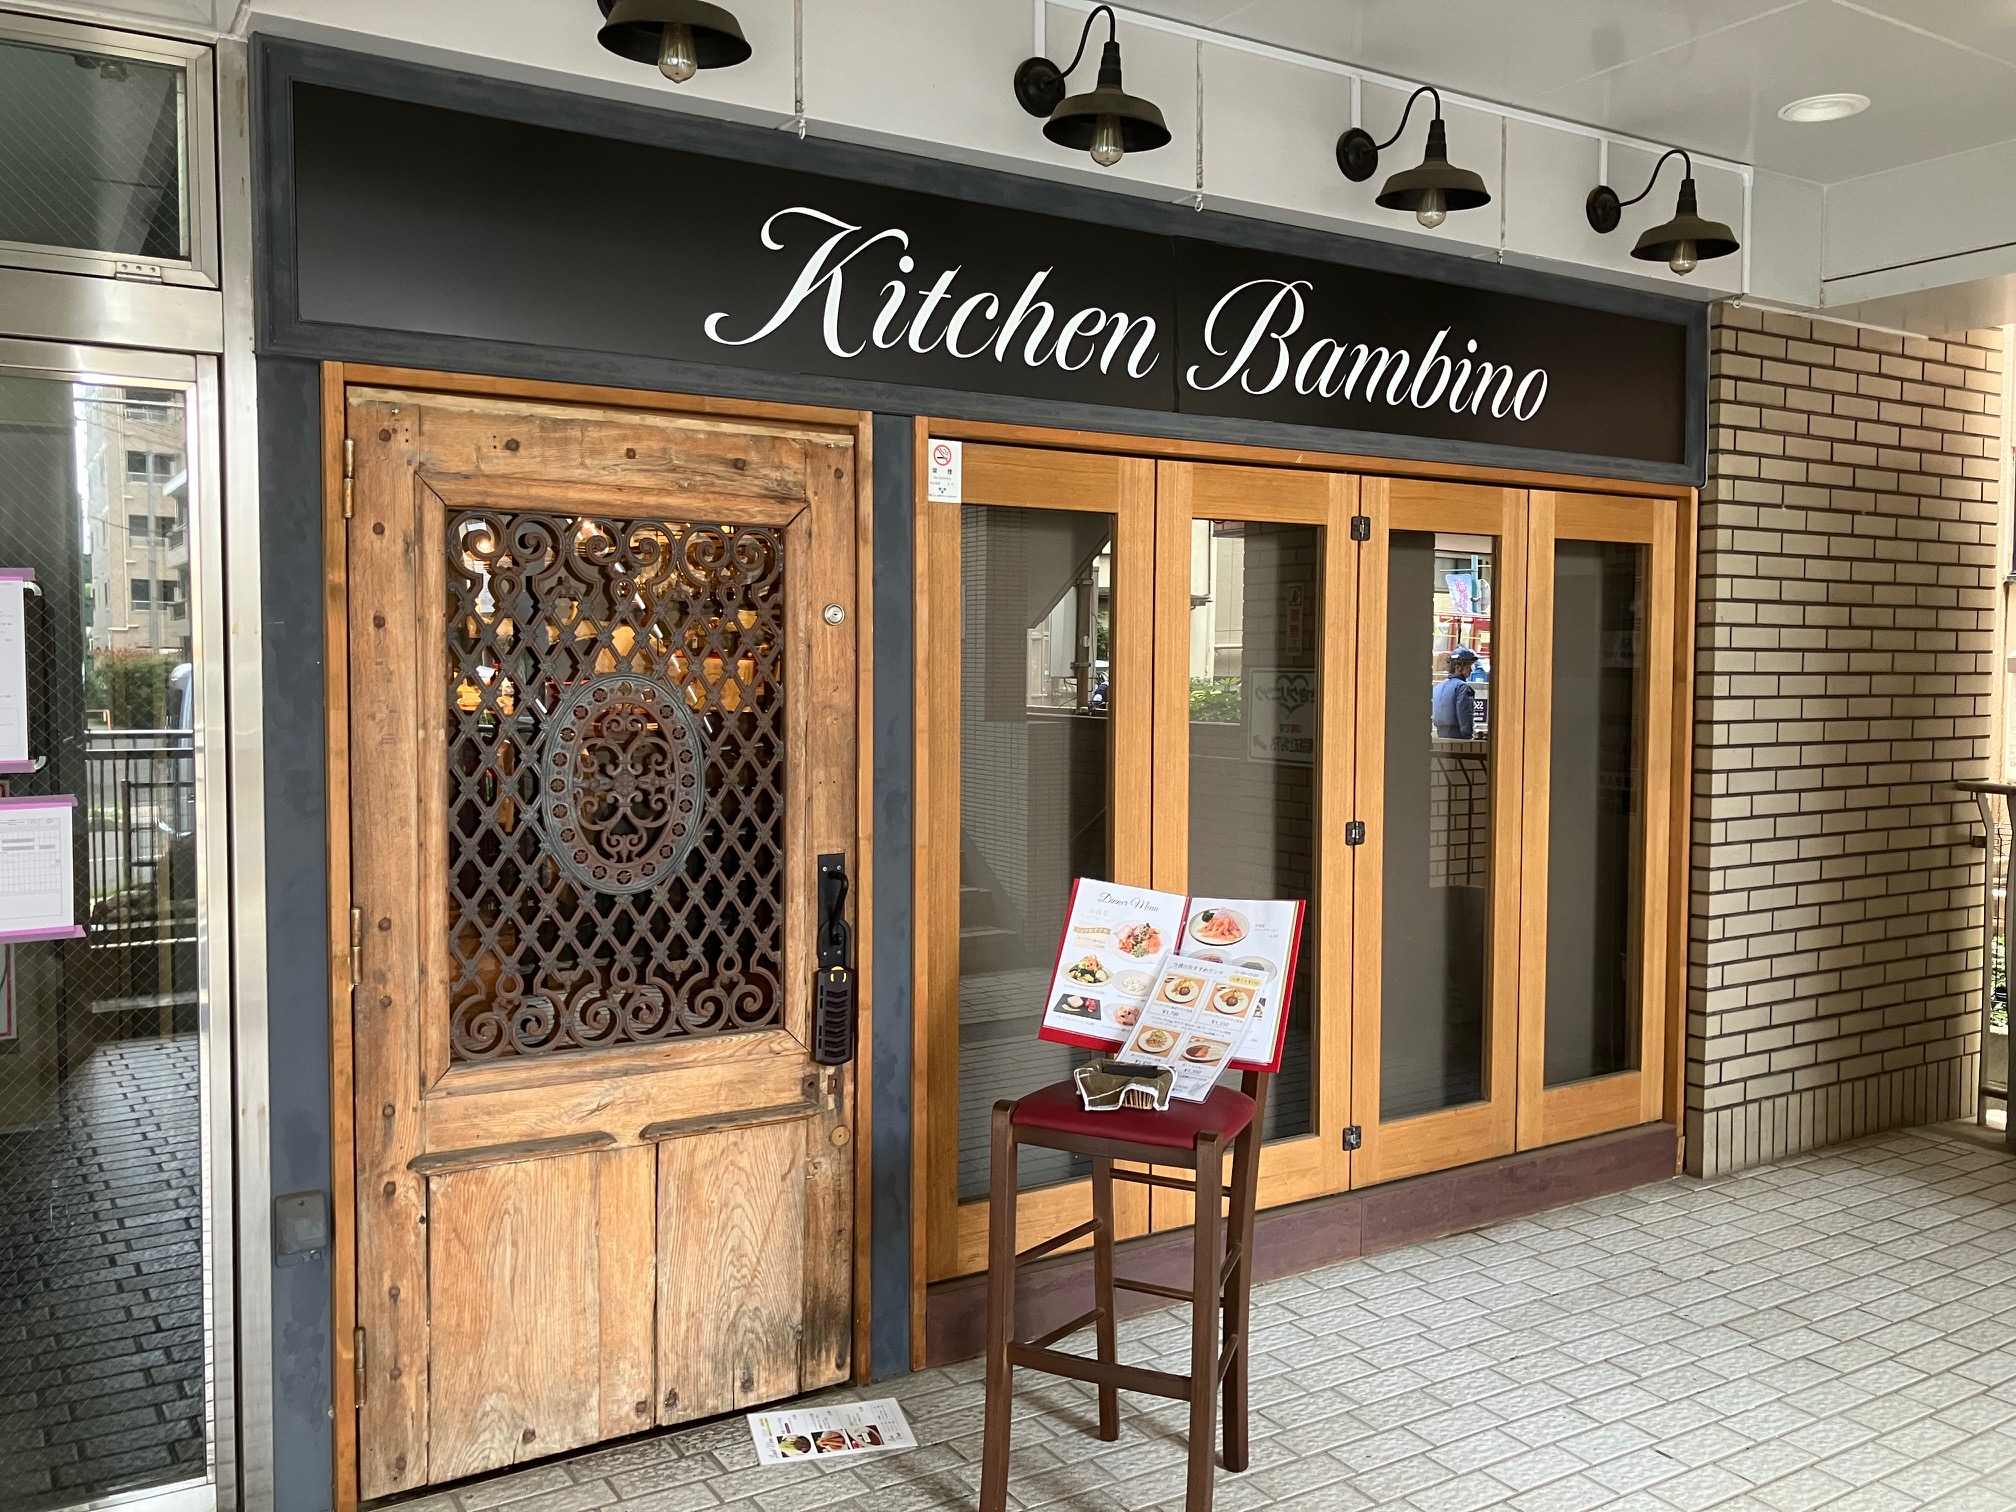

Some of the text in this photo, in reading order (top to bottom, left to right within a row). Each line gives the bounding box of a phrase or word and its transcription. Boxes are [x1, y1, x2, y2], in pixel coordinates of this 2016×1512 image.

[704, 206, 1548, 421] Kitchen Bambino
[1098, 892, 1159, 912] Dinner Menu
